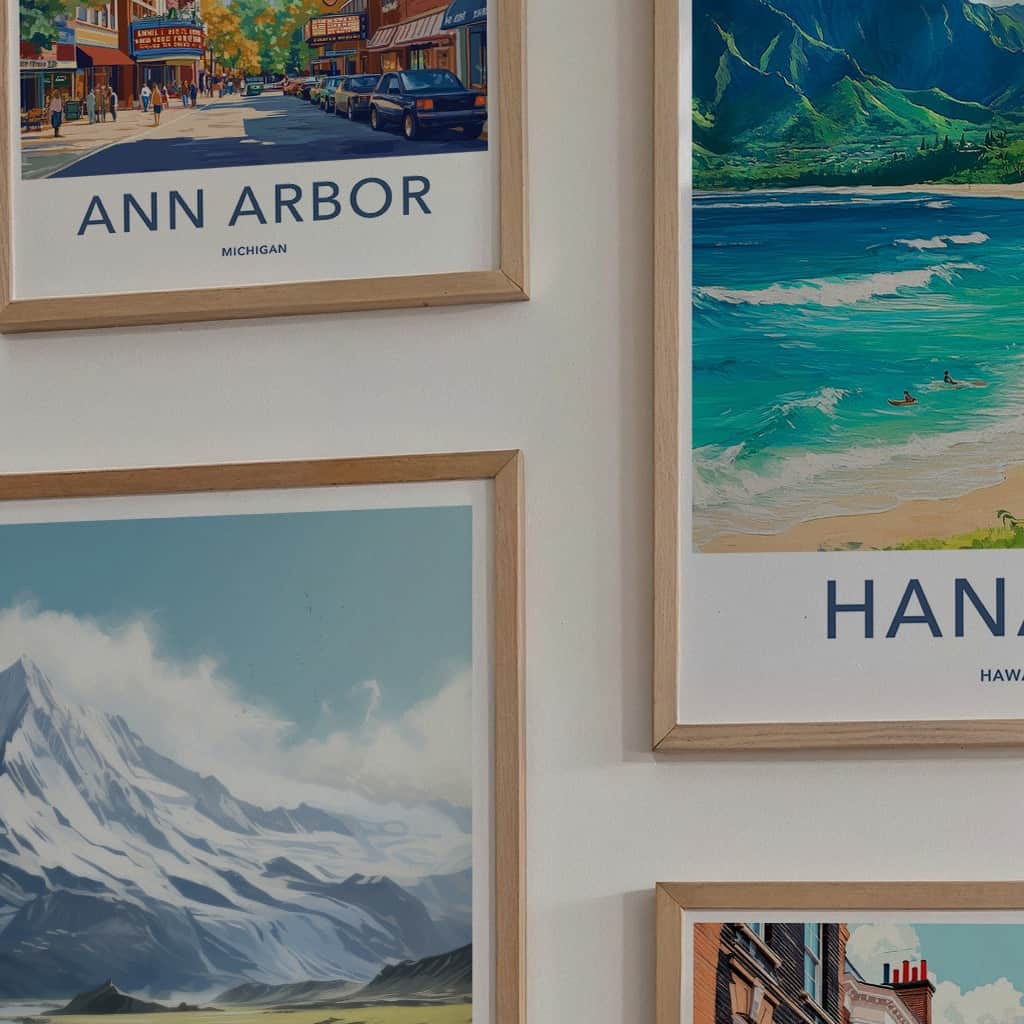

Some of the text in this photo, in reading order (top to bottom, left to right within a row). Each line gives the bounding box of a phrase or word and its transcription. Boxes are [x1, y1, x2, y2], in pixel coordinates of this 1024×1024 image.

[77, 175, 433, 236] ANN ARBOR
[221, 243, 288, 257] MICHIGAN
[827, 577, 1024, 640] HAN
[980, 668, 1024, 683] HAW
